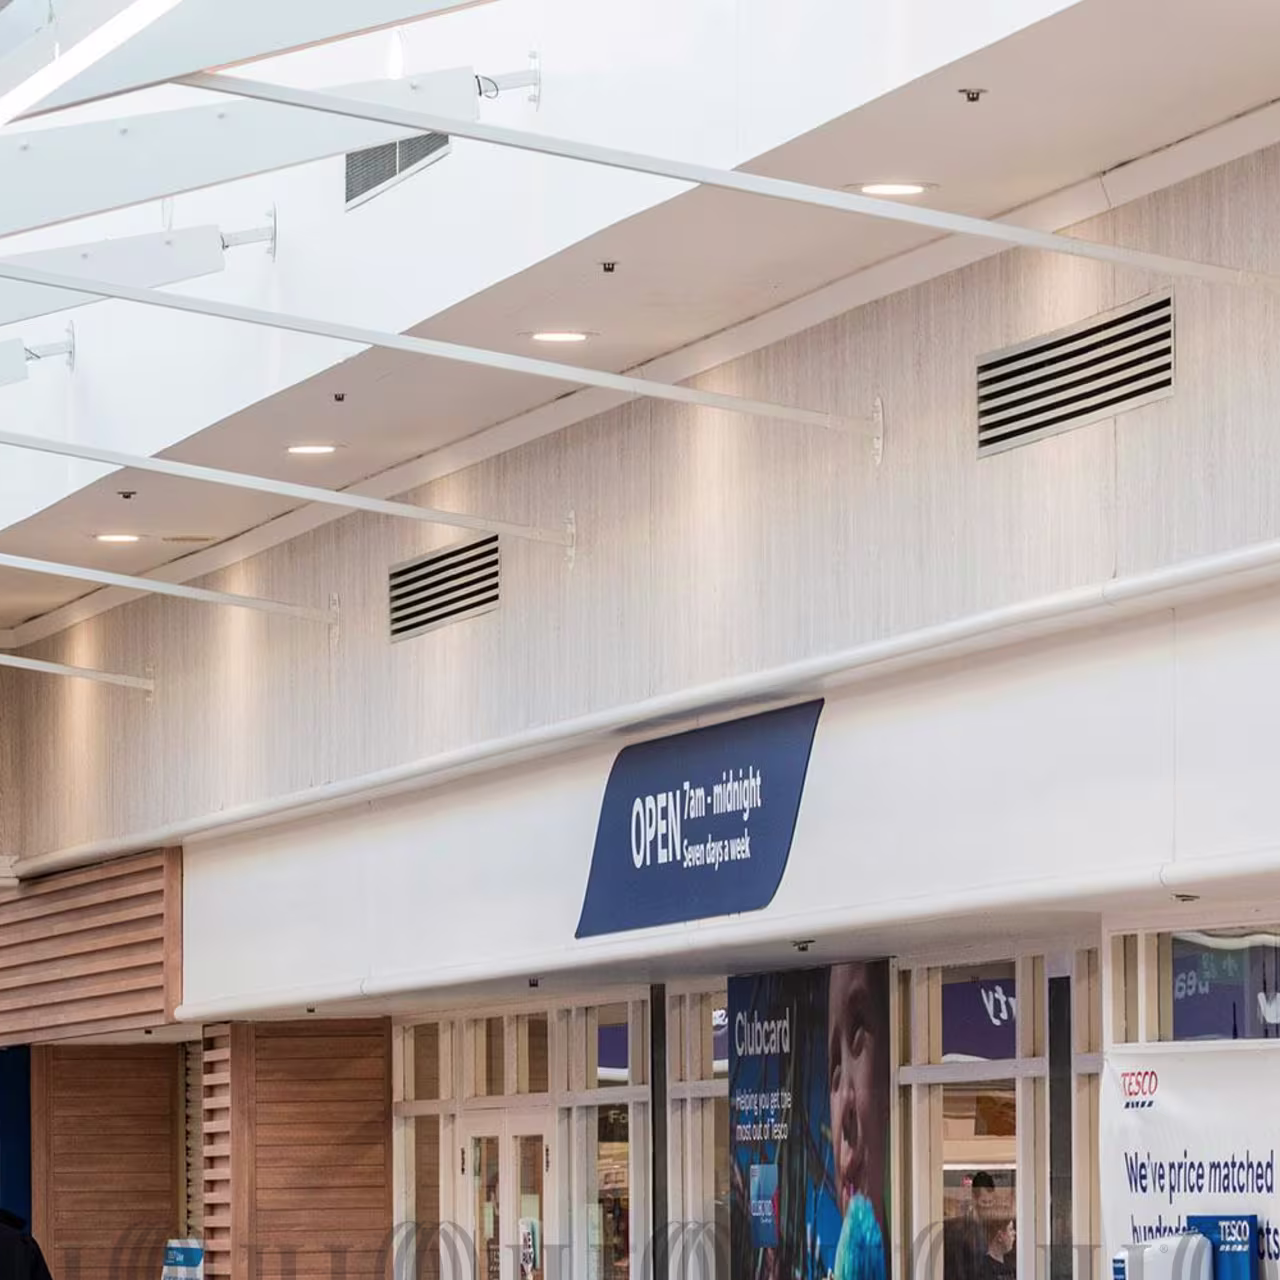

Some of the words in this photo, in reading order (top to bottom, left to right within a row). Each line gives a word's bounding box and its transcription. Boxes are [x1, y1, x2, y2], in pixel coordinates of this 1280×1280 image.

[683, 780, 706, 820] 7am
[713, 765, 761, 821] midnight
[630, 789, 682, 869] OPEN
[683, 838, 705, 868] Seven
[705, 833, 723, 871] days
[724, 839, 729, 862] a
[729, 827, 751, 860] week
[735, 1008, 791, 1057] Clubcard
[736, 1088, 758, 1116] Helping
[759, 1092, 770, 1116] you
[770, 1089, 780, 1116] get
[1121, 1070, 1158, 1097] TESCO
[736, 1120, 752, 1141] most
[753, 1120, 763, 1141] out
[763, 1118, 770, 1141] of
[771, 1118, 788, 1140] Tesco
[1124, 1151, 1165, 1193] We've
[1169, 1148, 1205, 1205] price
[1208, 1149, 1274, 1193] matched
[1218, 1220, 1250, 1242] TESCO
